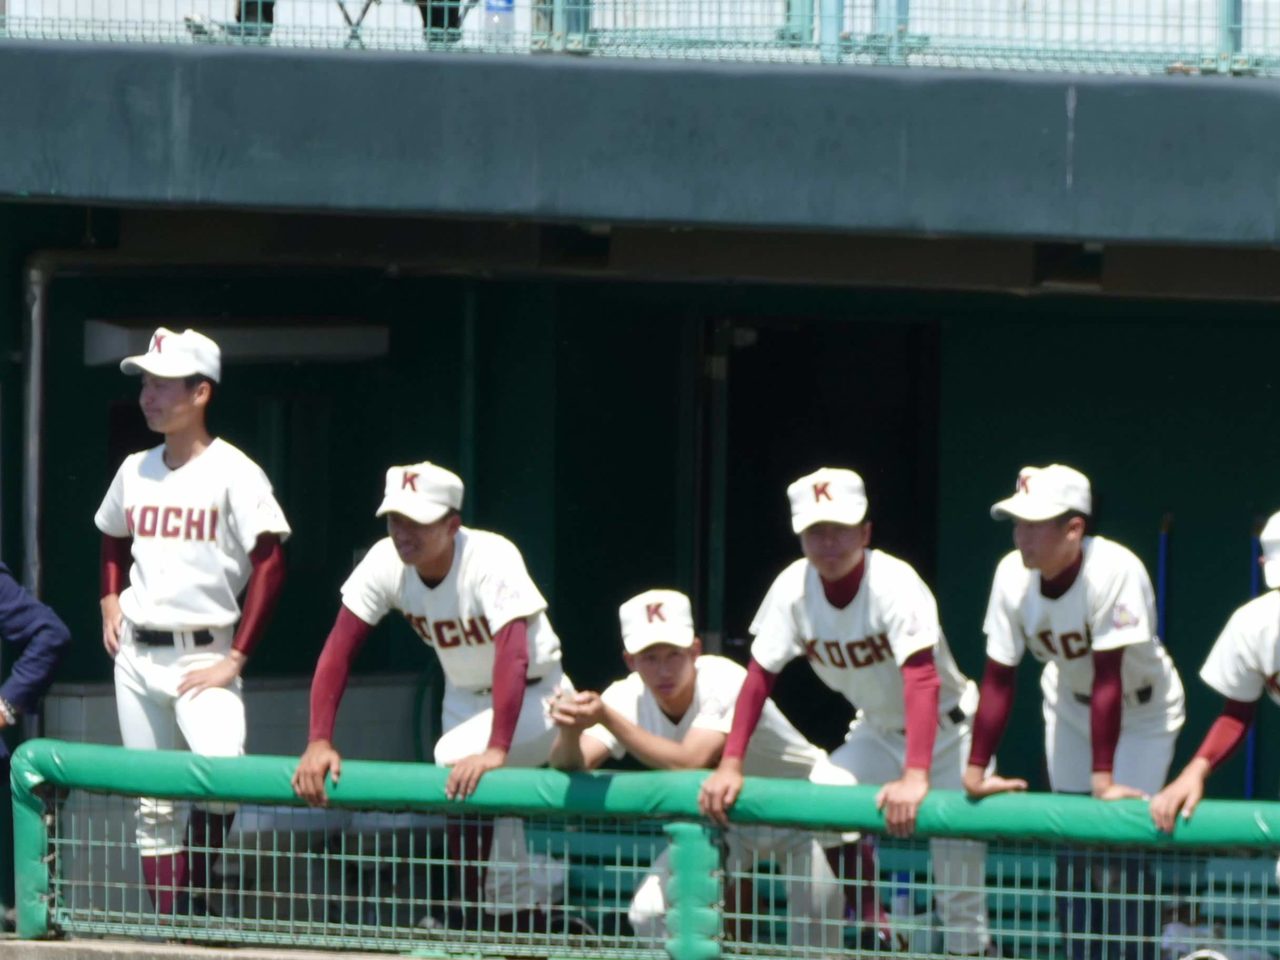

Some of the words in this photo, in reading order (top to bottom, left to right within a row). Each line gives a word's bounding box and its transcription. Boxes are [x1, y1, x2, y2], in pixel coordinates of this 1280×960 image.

[402, 471, 420, 492] K
[1017, 474, 1031, 494] K
[813, 482, 833, 503] K
[126, 506, 219, 542] KOCHI
[646, 602, 666, 623] K
[801, 633, 895, 669] KOCH
